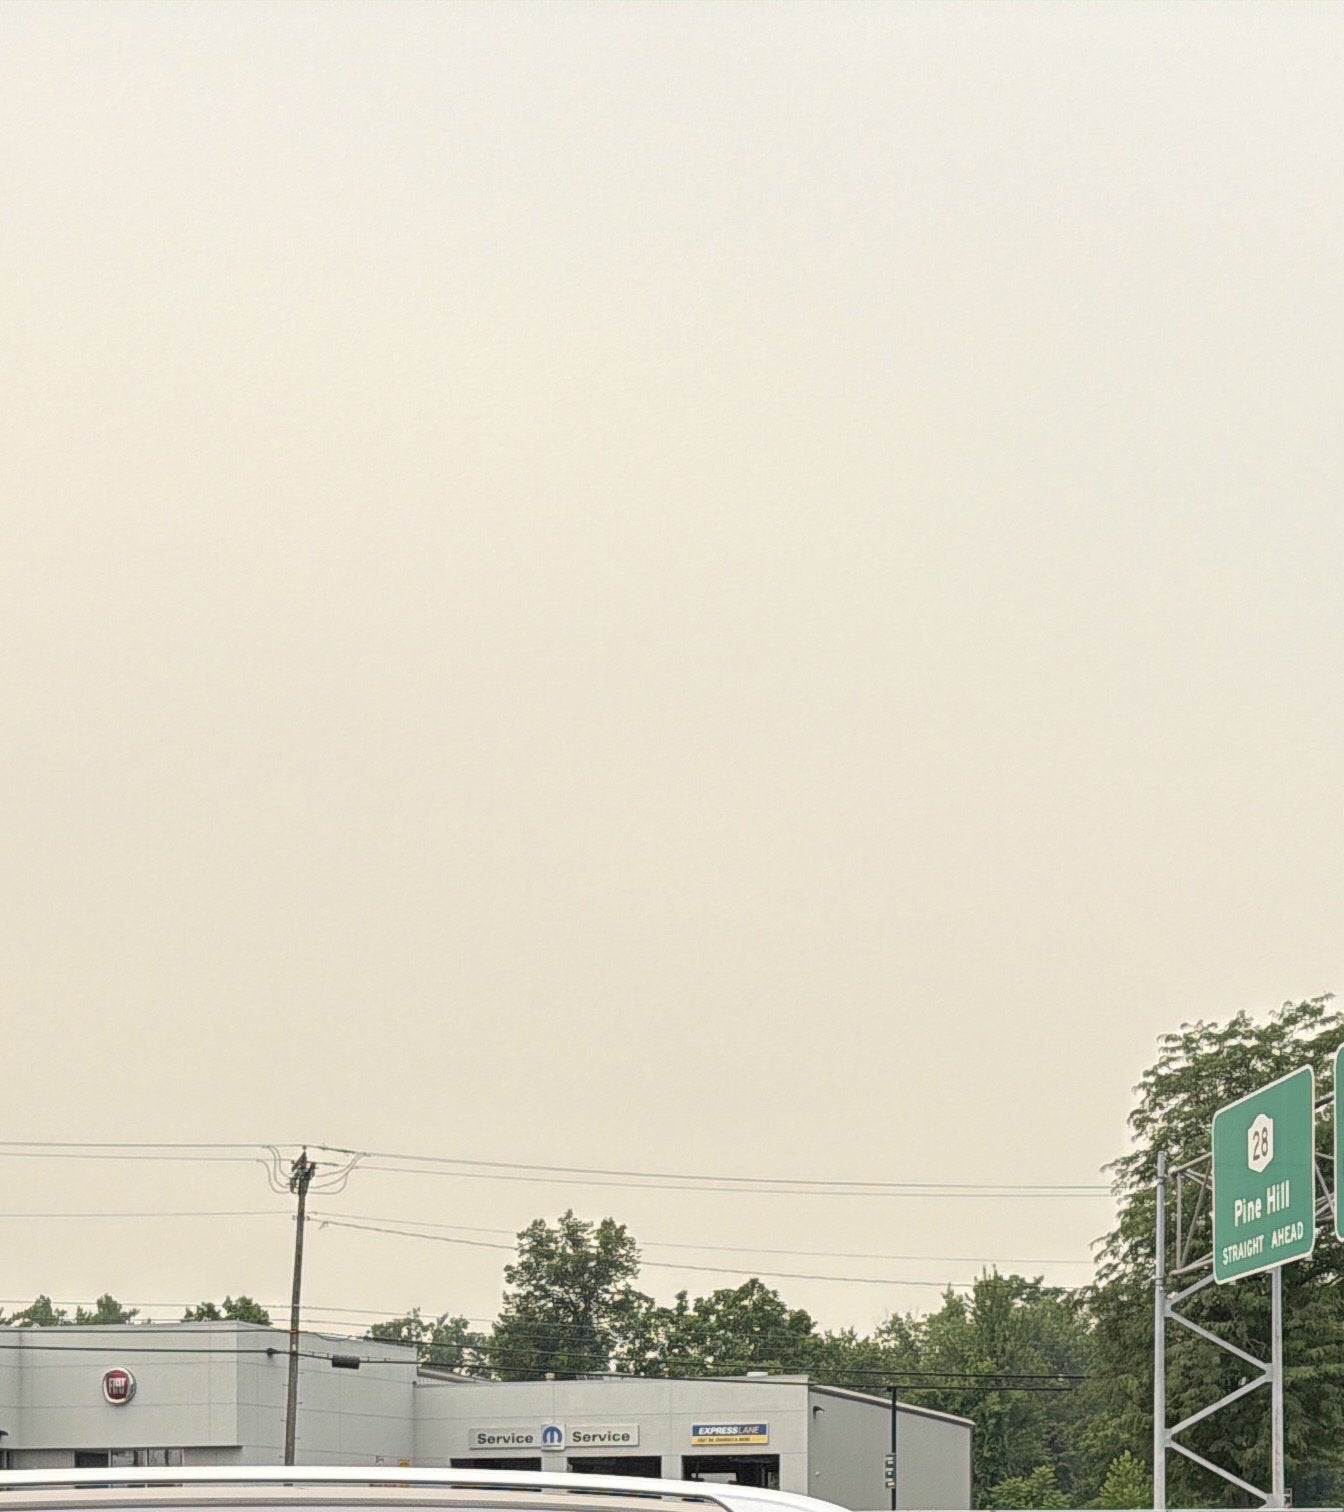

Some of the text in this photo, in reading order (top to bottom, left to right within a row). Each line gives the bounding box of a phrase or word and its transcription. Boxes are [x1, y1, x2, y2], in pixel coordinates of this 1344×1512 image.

[1252, 1126, 1269, 1162] 28
[1234, 1179, 1290, 1228] Pine Hill
[1222, 1220, 1304, 1266] STRAIGHT AHEAD
[477, 1433, 534, 1445] Service
[572, 1431, 631, 1443] Service
